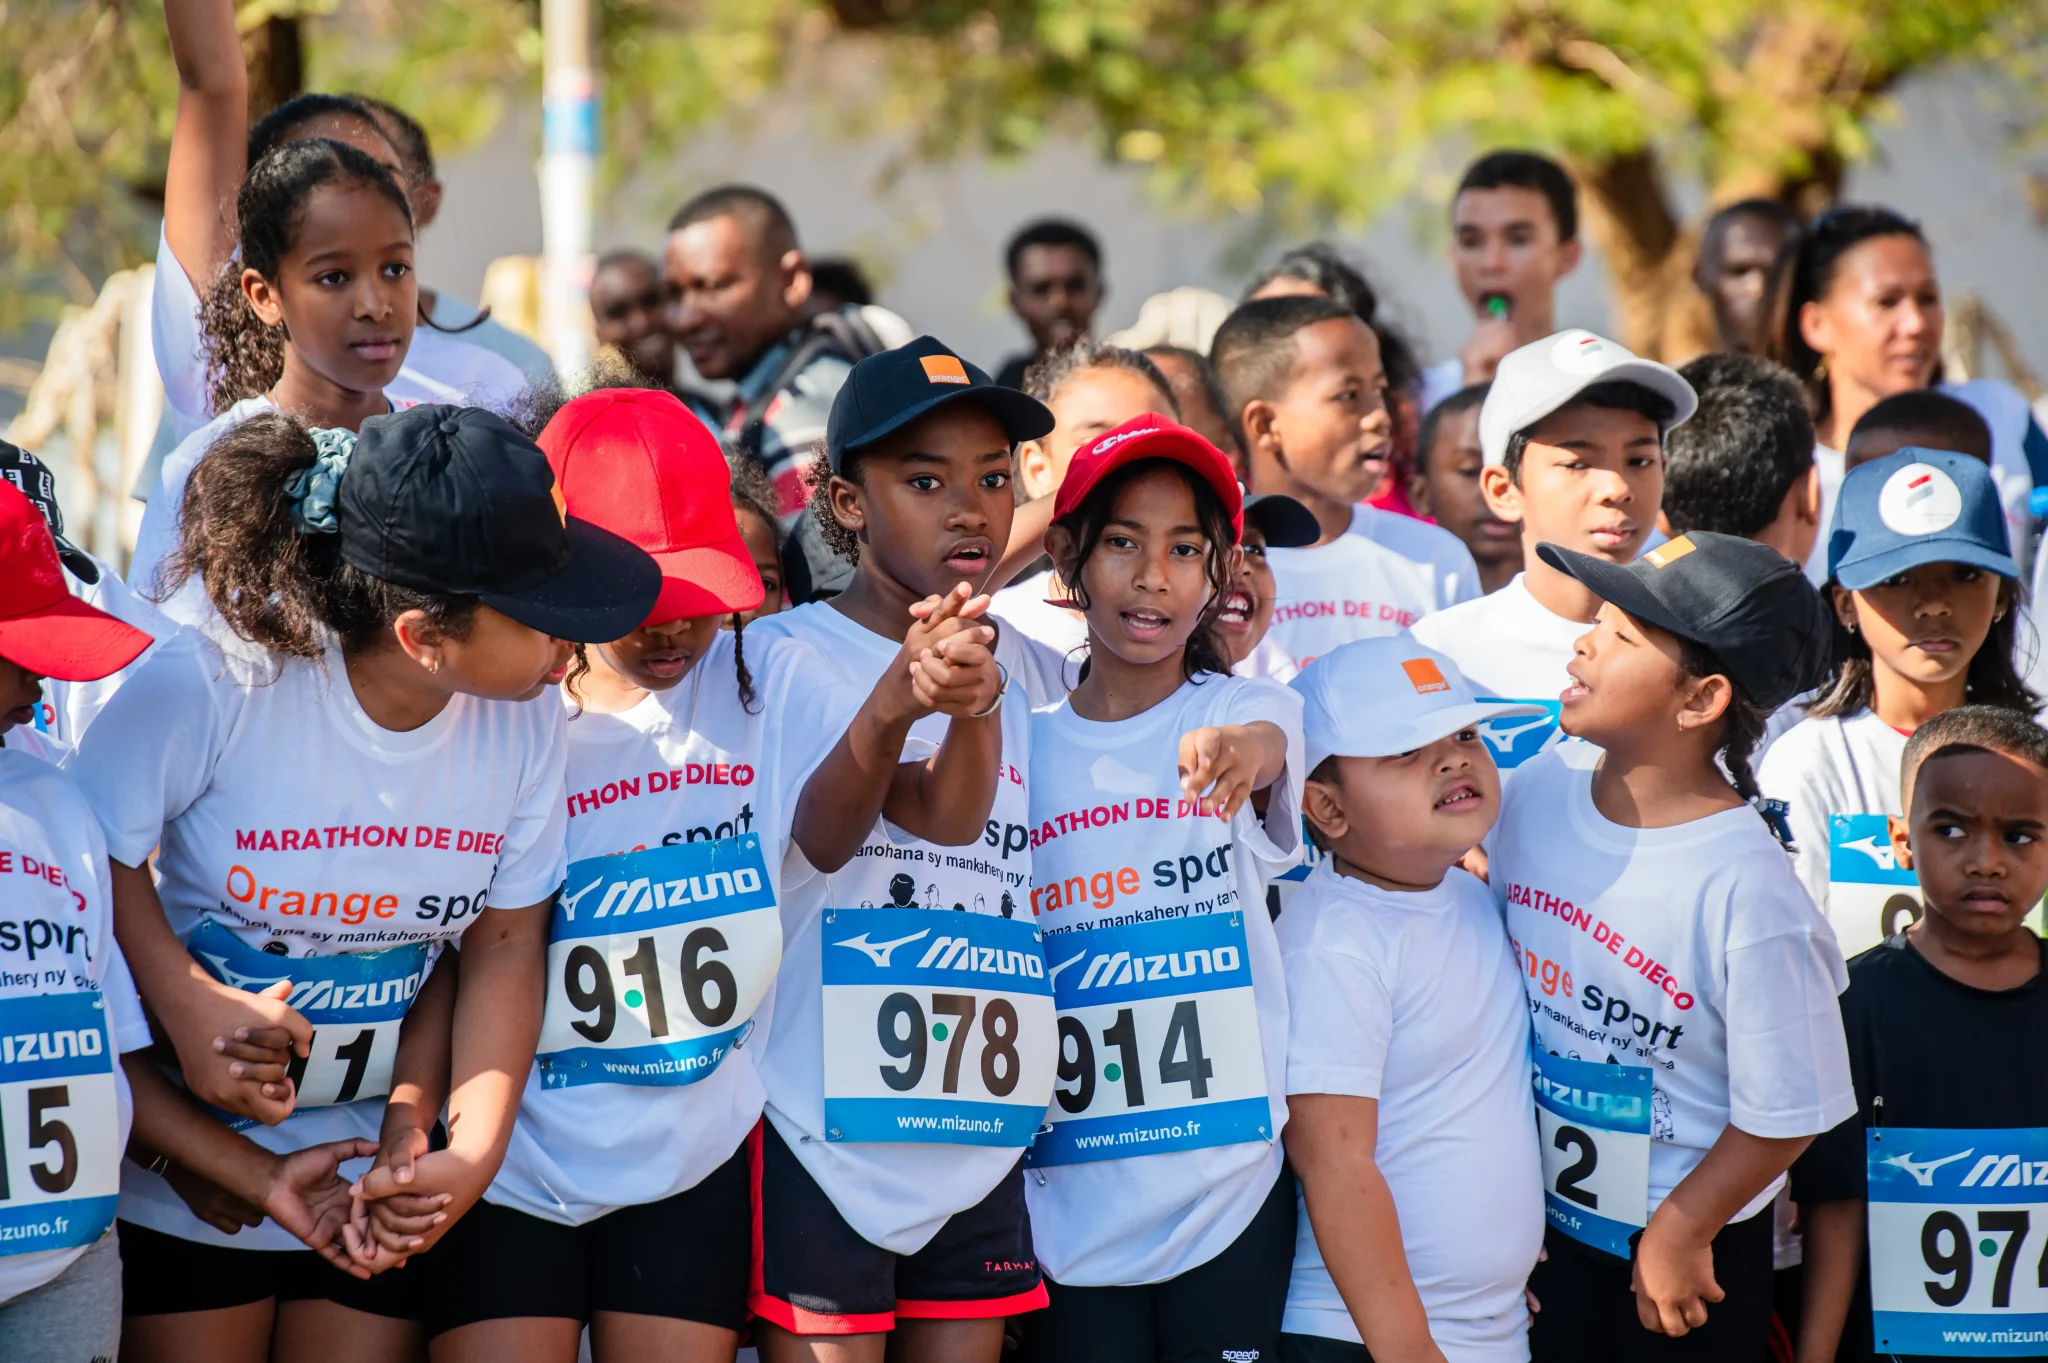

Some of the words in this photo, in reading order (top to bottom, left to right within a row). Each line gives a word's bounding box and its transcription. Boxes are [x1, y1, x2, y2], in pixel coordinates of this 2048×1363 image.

[930, 375, 965, 384] orange
[1343, 601, 1372, 618] DE
[1379, 604, 1415, 628] DIE
[648, 769, 683, 794] DE
[1136, 797, 1170, 819] DE
[236, 824, 407, 851] MARATHON
[414, 826, 452, 850] DE
[928, 851, 942, 868] sy
[1006, 871, 1025, 888] ny
[226, 864, 399, 925] Orange
[1100, 901, 1190, 929] mankahery
[1194, 898, 1214, 915] ny
[310, 932, 334, 943] sy
[337, 927, 437, 944] mankahery
[45, 969, 66, 986] ny
[1593, 920, 1625, 955] DE
[1623, 945, 1695, 1011] DIEGO
[565, 926, 739, 1043] 916
[1581, 984, 1685, 1049] sport
[877, 991, 1020, 1098] 978
[1055, 999, 1215, 1114] 914
[1611, 1036, 1632, 1050] ny
[602, 1048, 724, 1076] www.mizuno.fr
[896, 1114, 1005, 1134] www.mizuno.fr
[1075, 1121, 1201, 1150] www.mizuno.fr
[1921, 1210, 2048, 1308] 97
[1222, 1348, 1260, 1362] speedo
